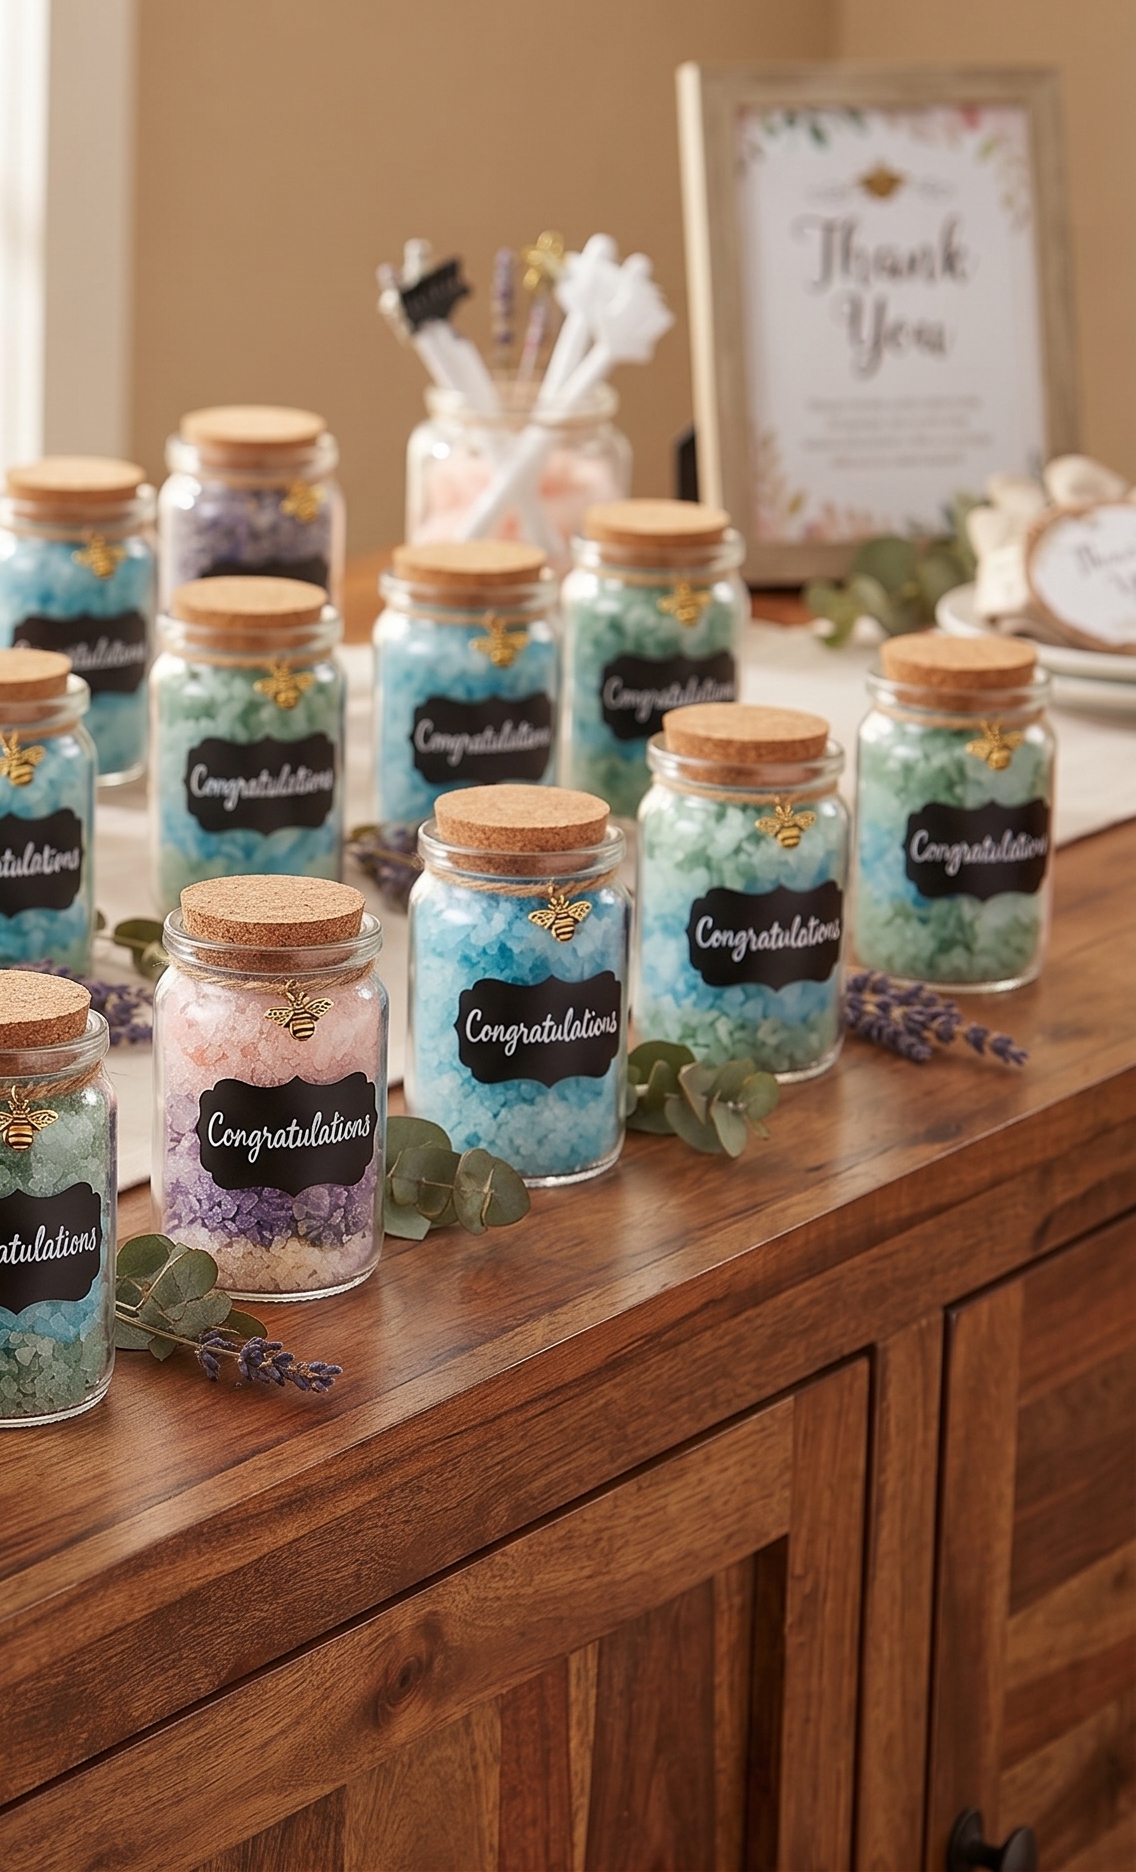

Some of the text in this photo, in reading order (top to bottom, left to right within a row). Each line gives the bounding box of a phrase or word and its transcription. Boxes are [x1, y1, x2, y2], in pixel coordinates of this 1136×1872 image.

[789, 212, 972, 297] Thank
[830, 290, 950, 382] You
[190, 763, 334, 812] Congratulations
[695, 914, 840, 963] Congratulations
[466, 1007, 618, 1057] Congratulations
[208, 1110, 371, 1164] Congratulations
